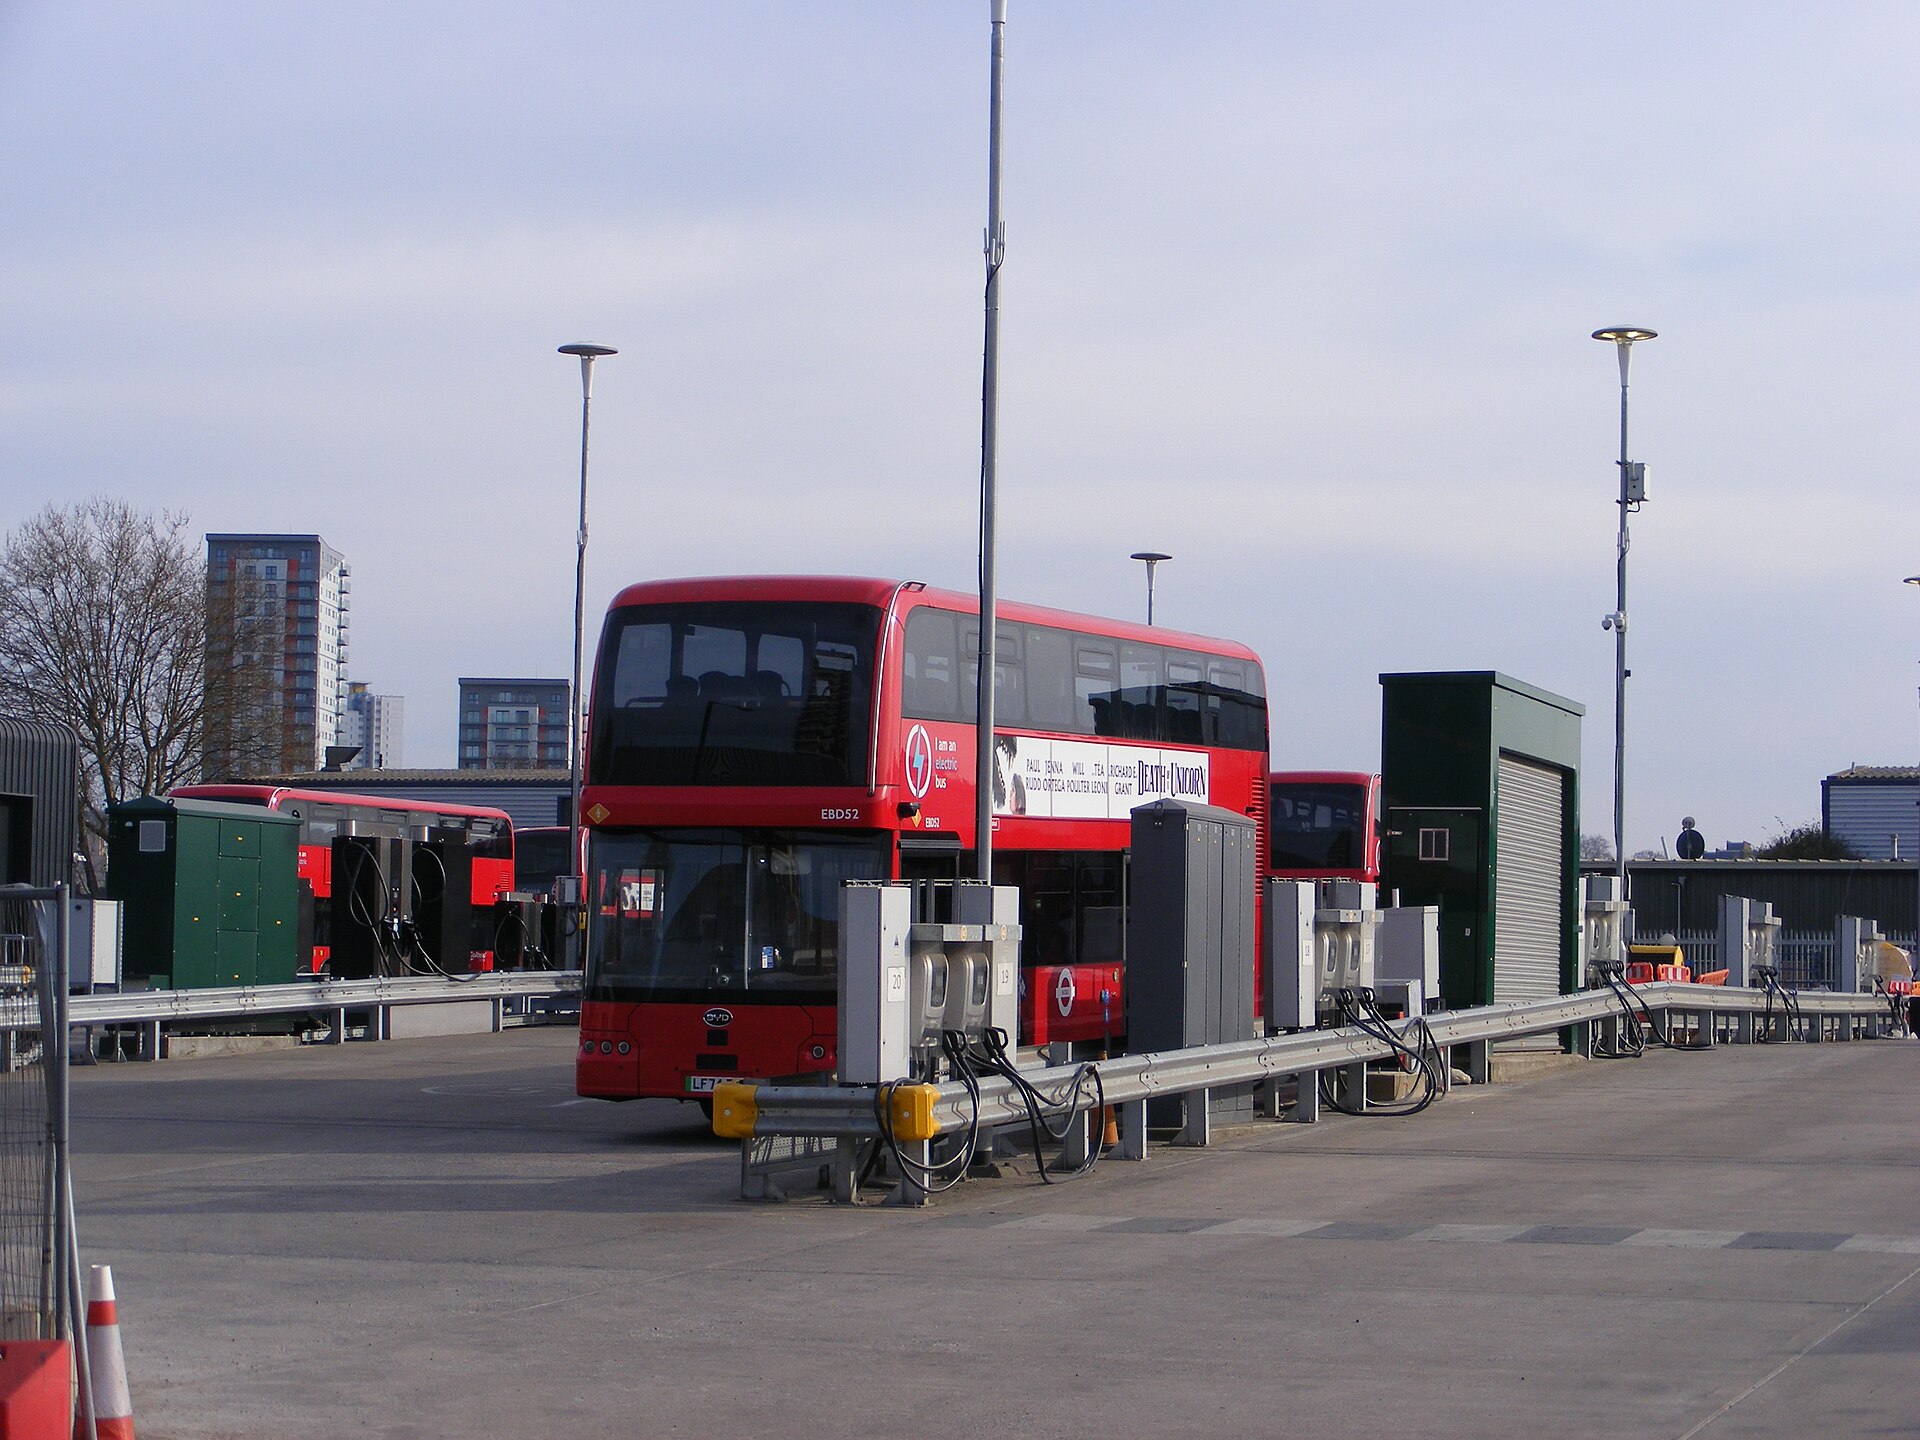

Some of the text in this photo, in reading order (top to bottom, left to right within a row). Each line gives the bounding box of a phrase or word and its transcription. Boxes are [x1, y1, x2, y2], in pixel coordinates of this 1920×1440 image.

[939, 740, 948, 752] am
[948, 740, 957, 752] an
[935, 757, 957, 770] electric
[1026, 759, 1040, 773] PAUL
[1044, 760, 1064, 775] JENNA
[1072, 762, 1085, 776] WILL
[1110, 765, 1132, 778] RICHARD
[935, 774, 947, 788] bus
[1138, 760, 1166, 795] DEATH
[1171, 763, 1206, 797] UNICORN
[1026, 777, 1132, 795] RUDD ORTEGA POULTER LEONI GRANT
[821, 808, 859, 820] EBD52
[925, 817, 939, 828] EBD52
[893, 974, 901, 989] 20
[1001, 969, 1009, 984] 19
[706, 1013, 730, 1021] BYD
